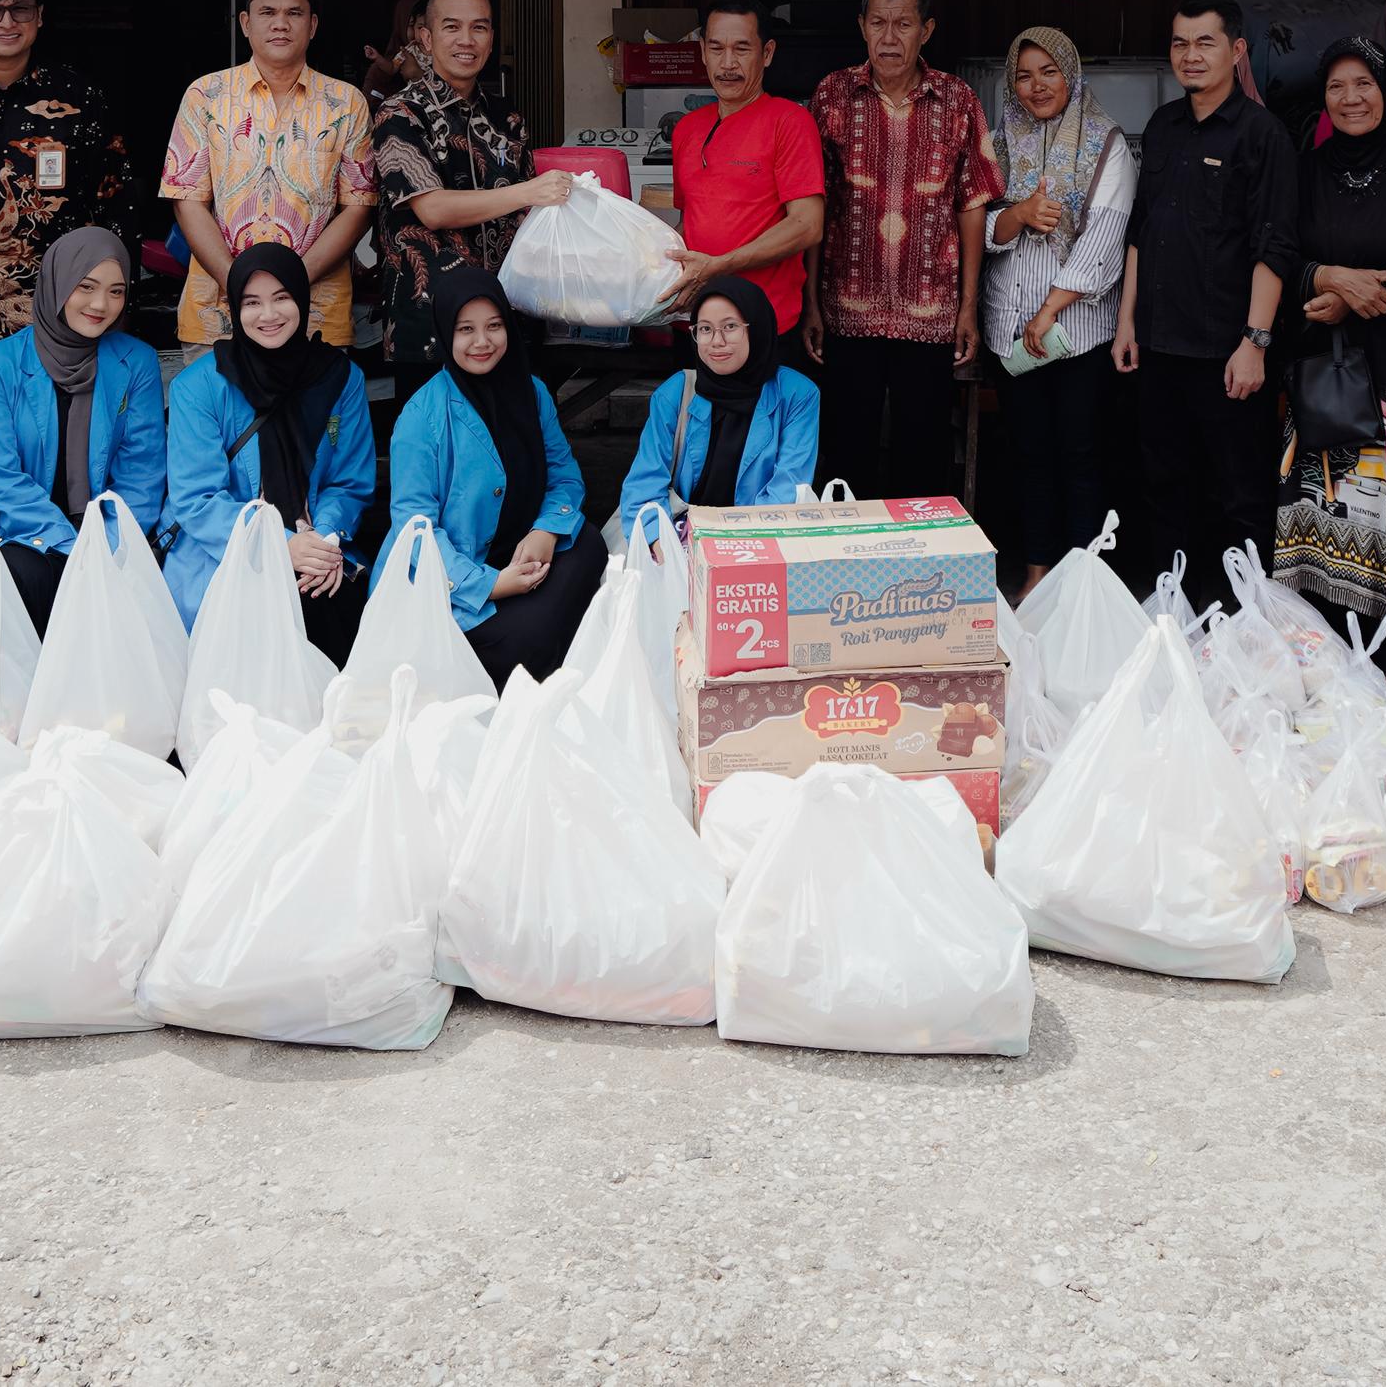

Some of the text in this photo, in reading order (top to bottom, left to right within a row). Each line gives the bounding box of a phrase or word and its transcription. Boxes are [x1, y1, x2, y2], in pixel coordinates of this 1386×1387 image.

[1350, 506, 1381, 519] VALENTINO
[732, 550, 759, 563] 2
[716, 582, 778, 598] EKSTRA
[716, 597, 779, 615] GRATIS
[830, 584, 958, 626] Padimas
[735, 618, 765, 659] 2
[760, 639, 780, 649] PCS
[841, 622, 948, 647] Roti Panggang
[833, 721, 873, 730] BAKERY
[827, 744, 881, 754] ROTI MANIS
[819, 752, 889, 762] RASA COKELAT
